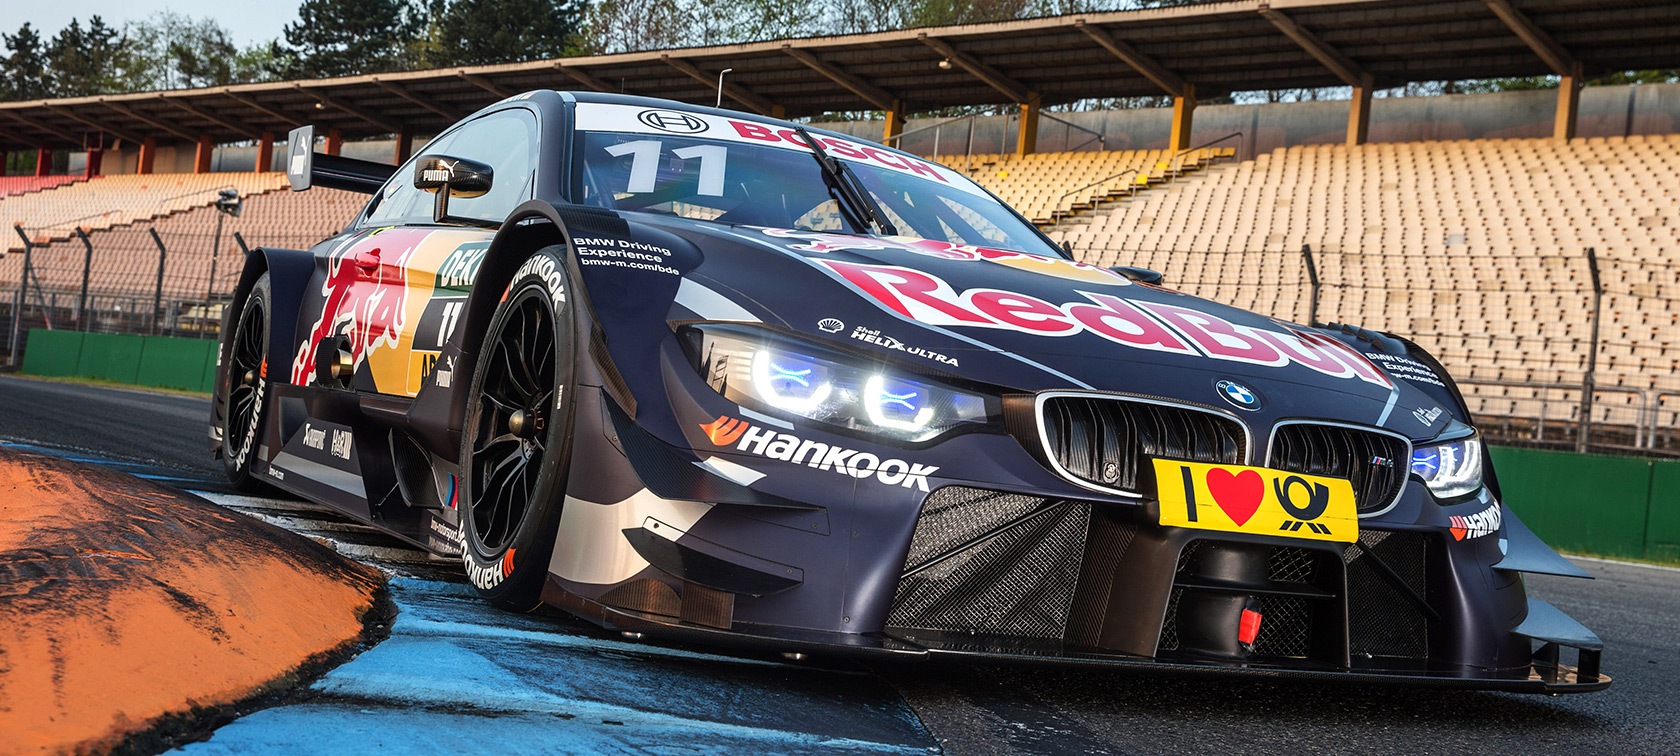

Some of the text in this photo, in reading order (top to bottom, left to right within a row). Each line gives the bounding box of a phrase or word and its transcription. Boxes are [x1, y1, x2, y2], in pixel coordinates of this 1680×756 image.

[728, 120, 950, 183] BOSCH
[423, 169, 449, 182] PUMA
[603, 139, 728, 197] 11
[573, 237, 672, 256] BMW Driving
[577, 246, 663, 263] Experience
[580, 257, 680, 276] bmw-m.com/bde
[855, 325, 881, 337] Shell
[850, 330, 960, 368] HELIX ULTRA
[1365, 352, 1396, 362] BMW
[1180, 466, 1198, 523] I
